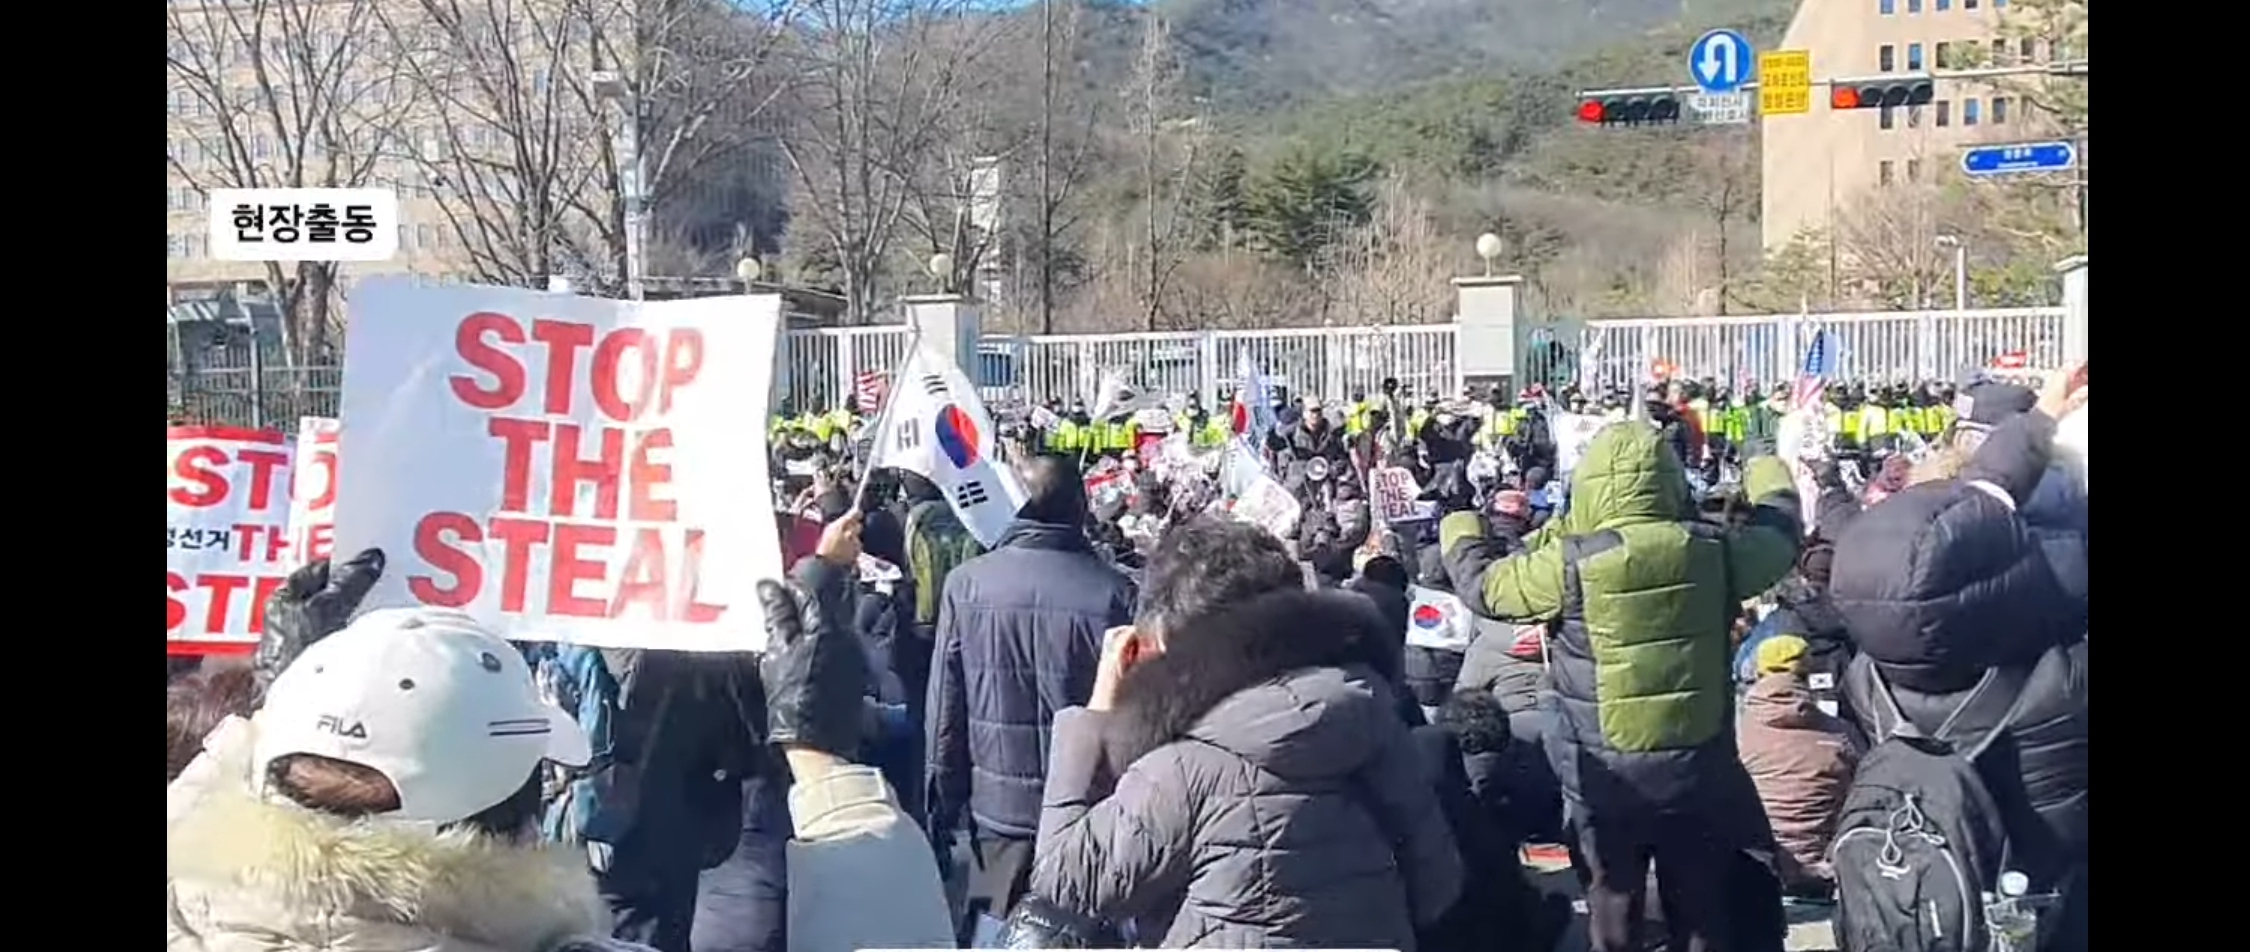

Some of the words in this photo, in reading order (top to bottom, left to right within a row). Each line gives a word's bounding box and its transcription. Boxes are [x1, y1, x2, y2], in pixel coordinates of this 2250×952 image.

[449, 311, 704, 422] STOP
[488, 417, 677, 522] THE
[1379, 487, 1408, 502] THE
[1382, 501, 1419, 519] TEAL
[406, 511, 728, 623] STEAL
[316, 714, 367, 739] FILA
